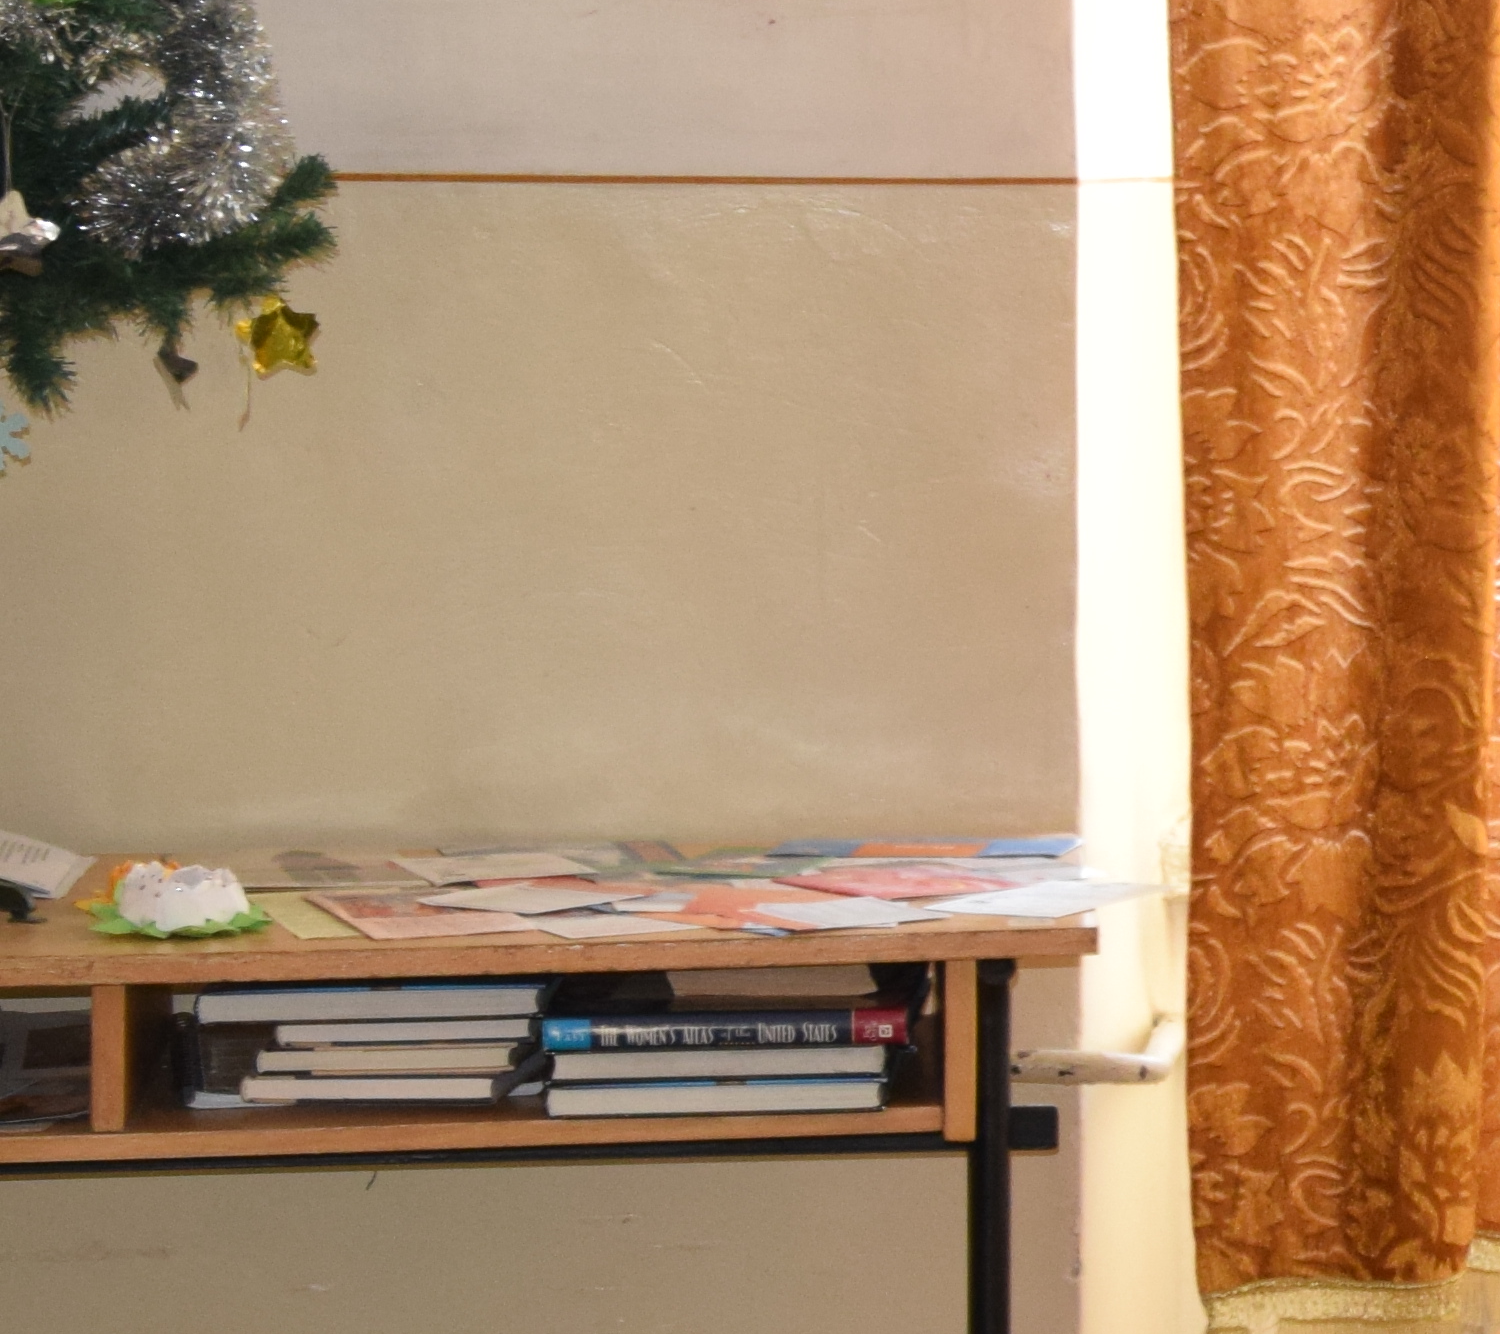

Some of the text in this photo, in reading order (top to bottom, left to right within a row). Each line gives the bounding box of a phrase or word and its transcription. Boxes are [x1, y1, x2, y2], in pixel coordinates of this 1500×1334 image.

[601, 1024, 619, 1046] THE
[683, 1026, 714, 1045] ATLAS
[758, 1022, 796, 1044] UNITED
[802, 1022, 837, 1043] STATES
